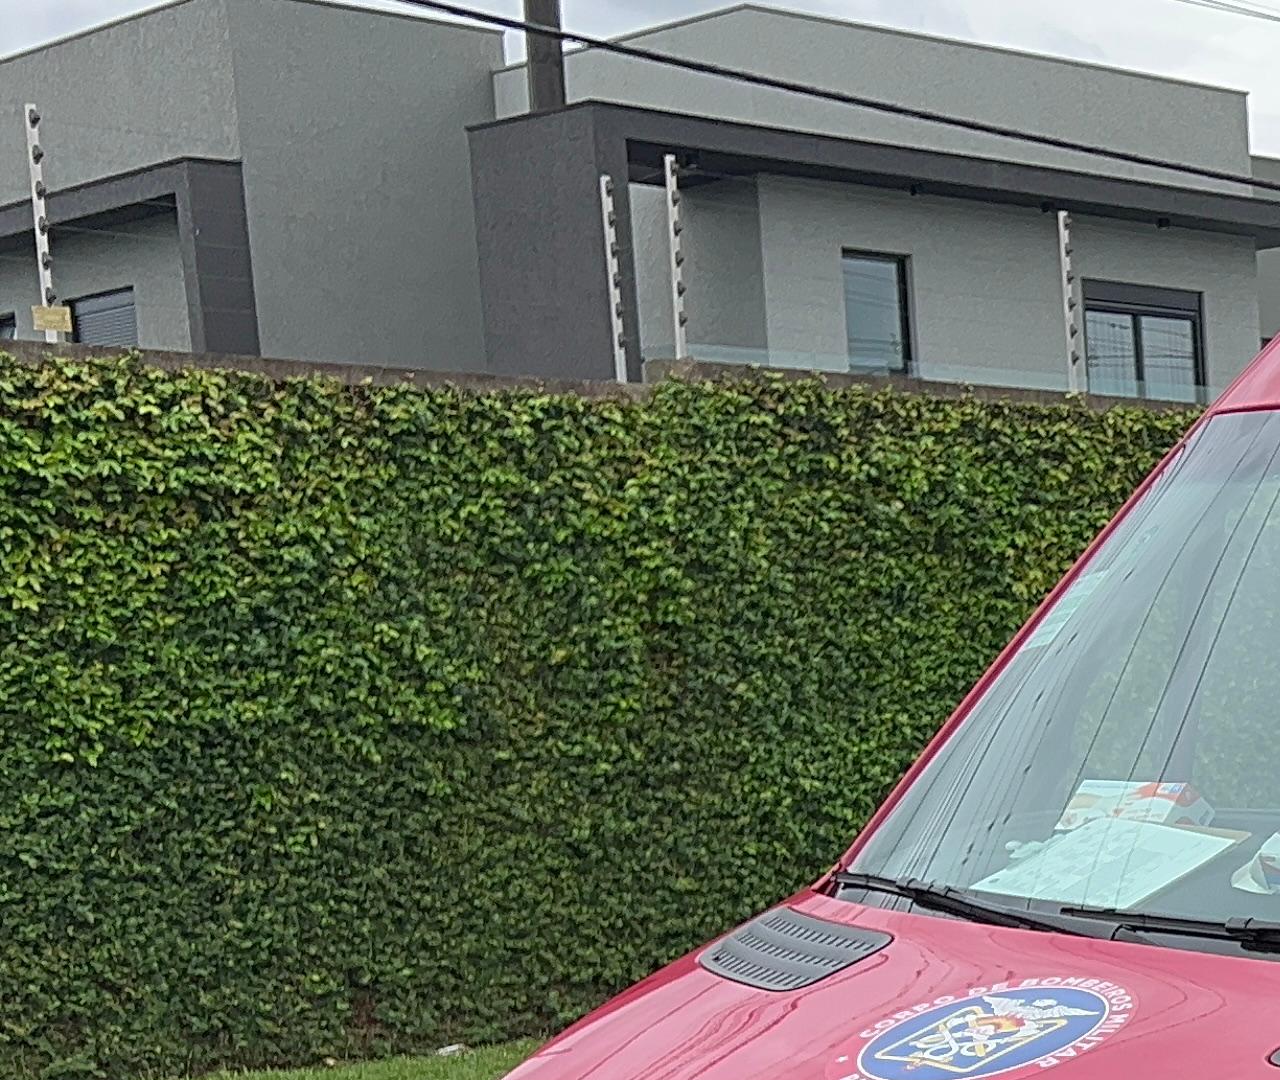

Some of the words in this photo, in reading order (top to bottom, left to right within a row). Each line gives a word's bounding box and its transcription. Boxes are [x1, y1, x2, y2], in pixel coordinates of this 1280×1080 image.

[968, 982, 1010, 998] DE
[1020, 976, 1133, 1014] BOMBEIROS
[858, 995, 956, 1040] CORPO
[1037, 1012, 1131, 1069] MILITAR
